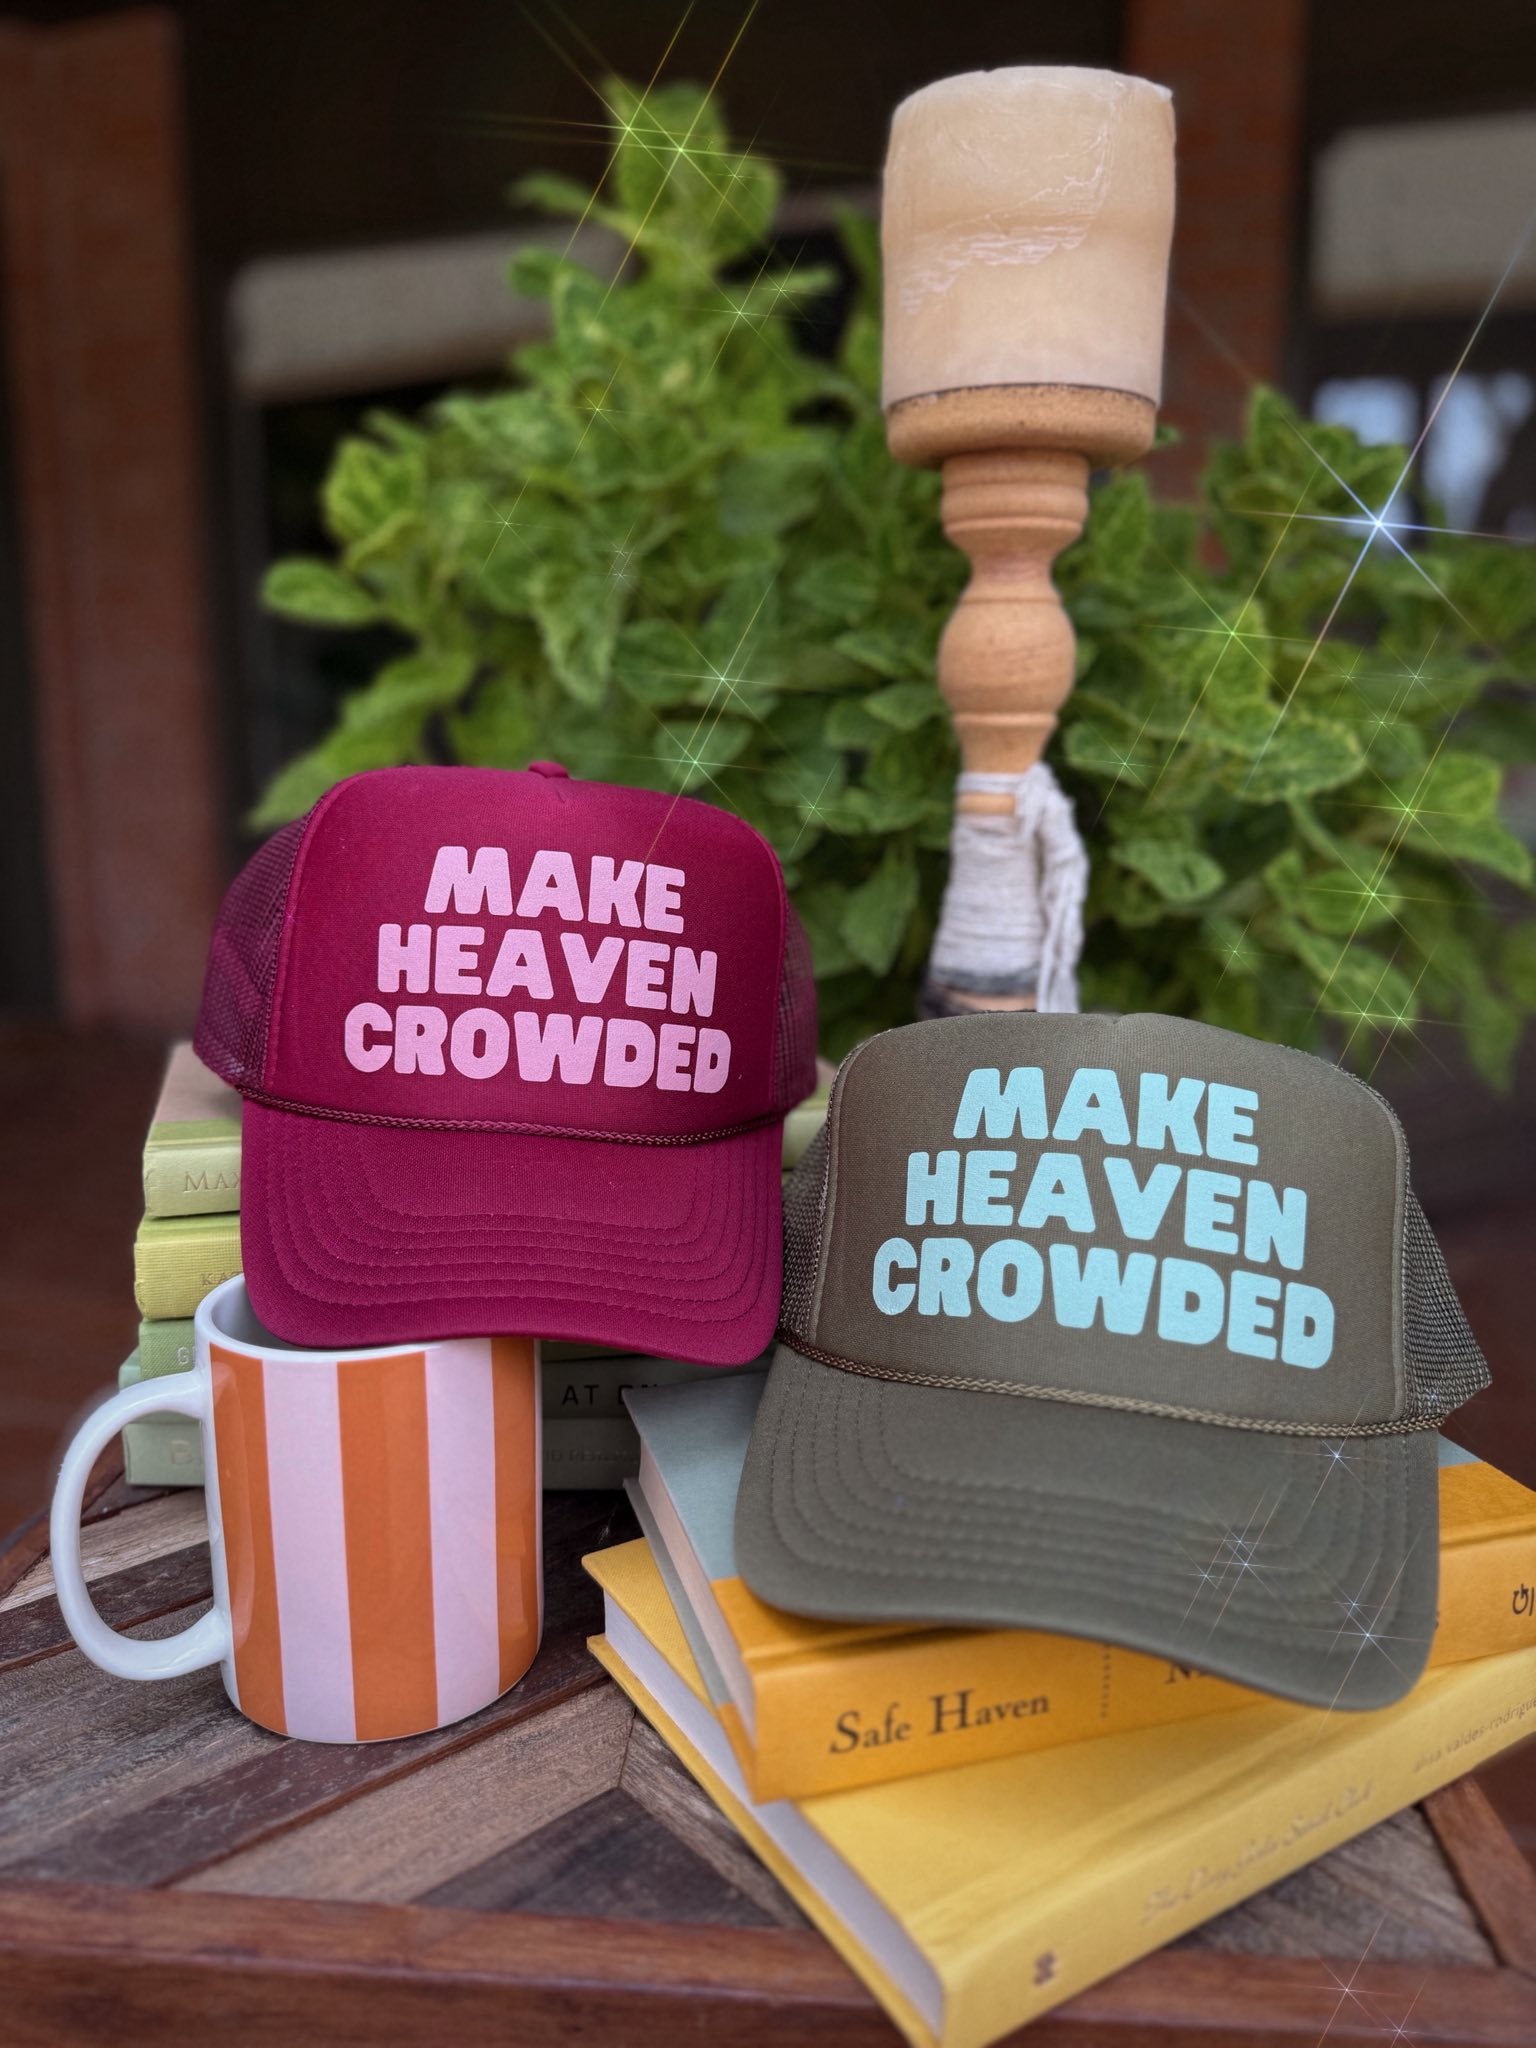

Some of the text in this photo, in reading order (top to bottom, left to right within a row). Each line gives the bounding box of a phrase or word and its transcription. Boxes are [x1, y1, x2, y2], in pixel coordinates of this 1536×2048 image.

[424, 845, 686, 934] MAKE
[377, 923, 718, 1018] HEAVEN
[344, 1002, 732, 1094] CROWDED
[952, 1066, 1260, 1167] MAKE
[905, 1149, 1308, 1272] HEAVEN
[872, 1237, 1336, 1370] CROWDED
[561, 1383, 600, 1406] AT
[829, 1688, 1050, 1754] Safe Haven
